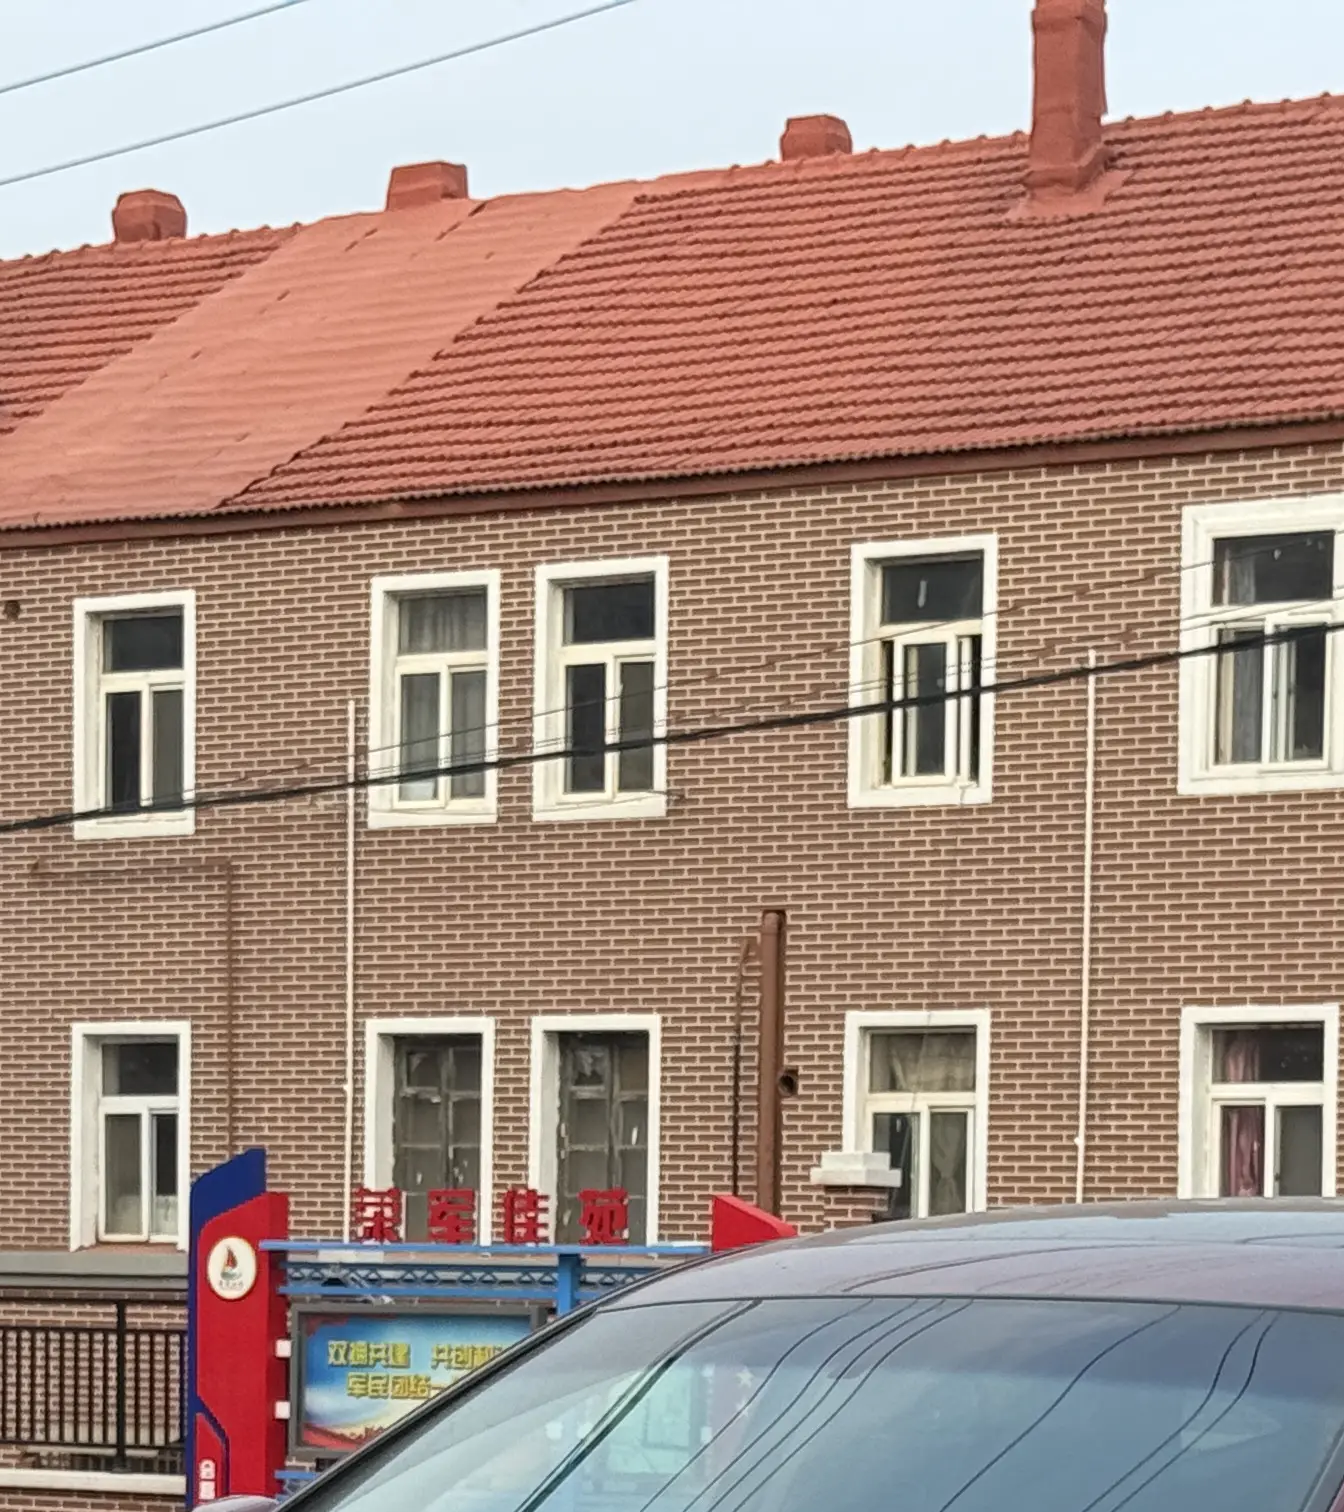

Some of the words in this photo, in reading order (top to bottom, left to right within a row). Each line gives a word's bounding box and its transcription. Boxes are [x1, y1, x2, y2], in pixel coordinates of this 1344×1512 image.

[355, 1186, 629, 1245] 荣军佳苑
[327, 1340, 411, 1369] 双拥共建
[431, 1343, 504, 1370] 共创和
[347, 1371, 459, 1399] 军民团结一
